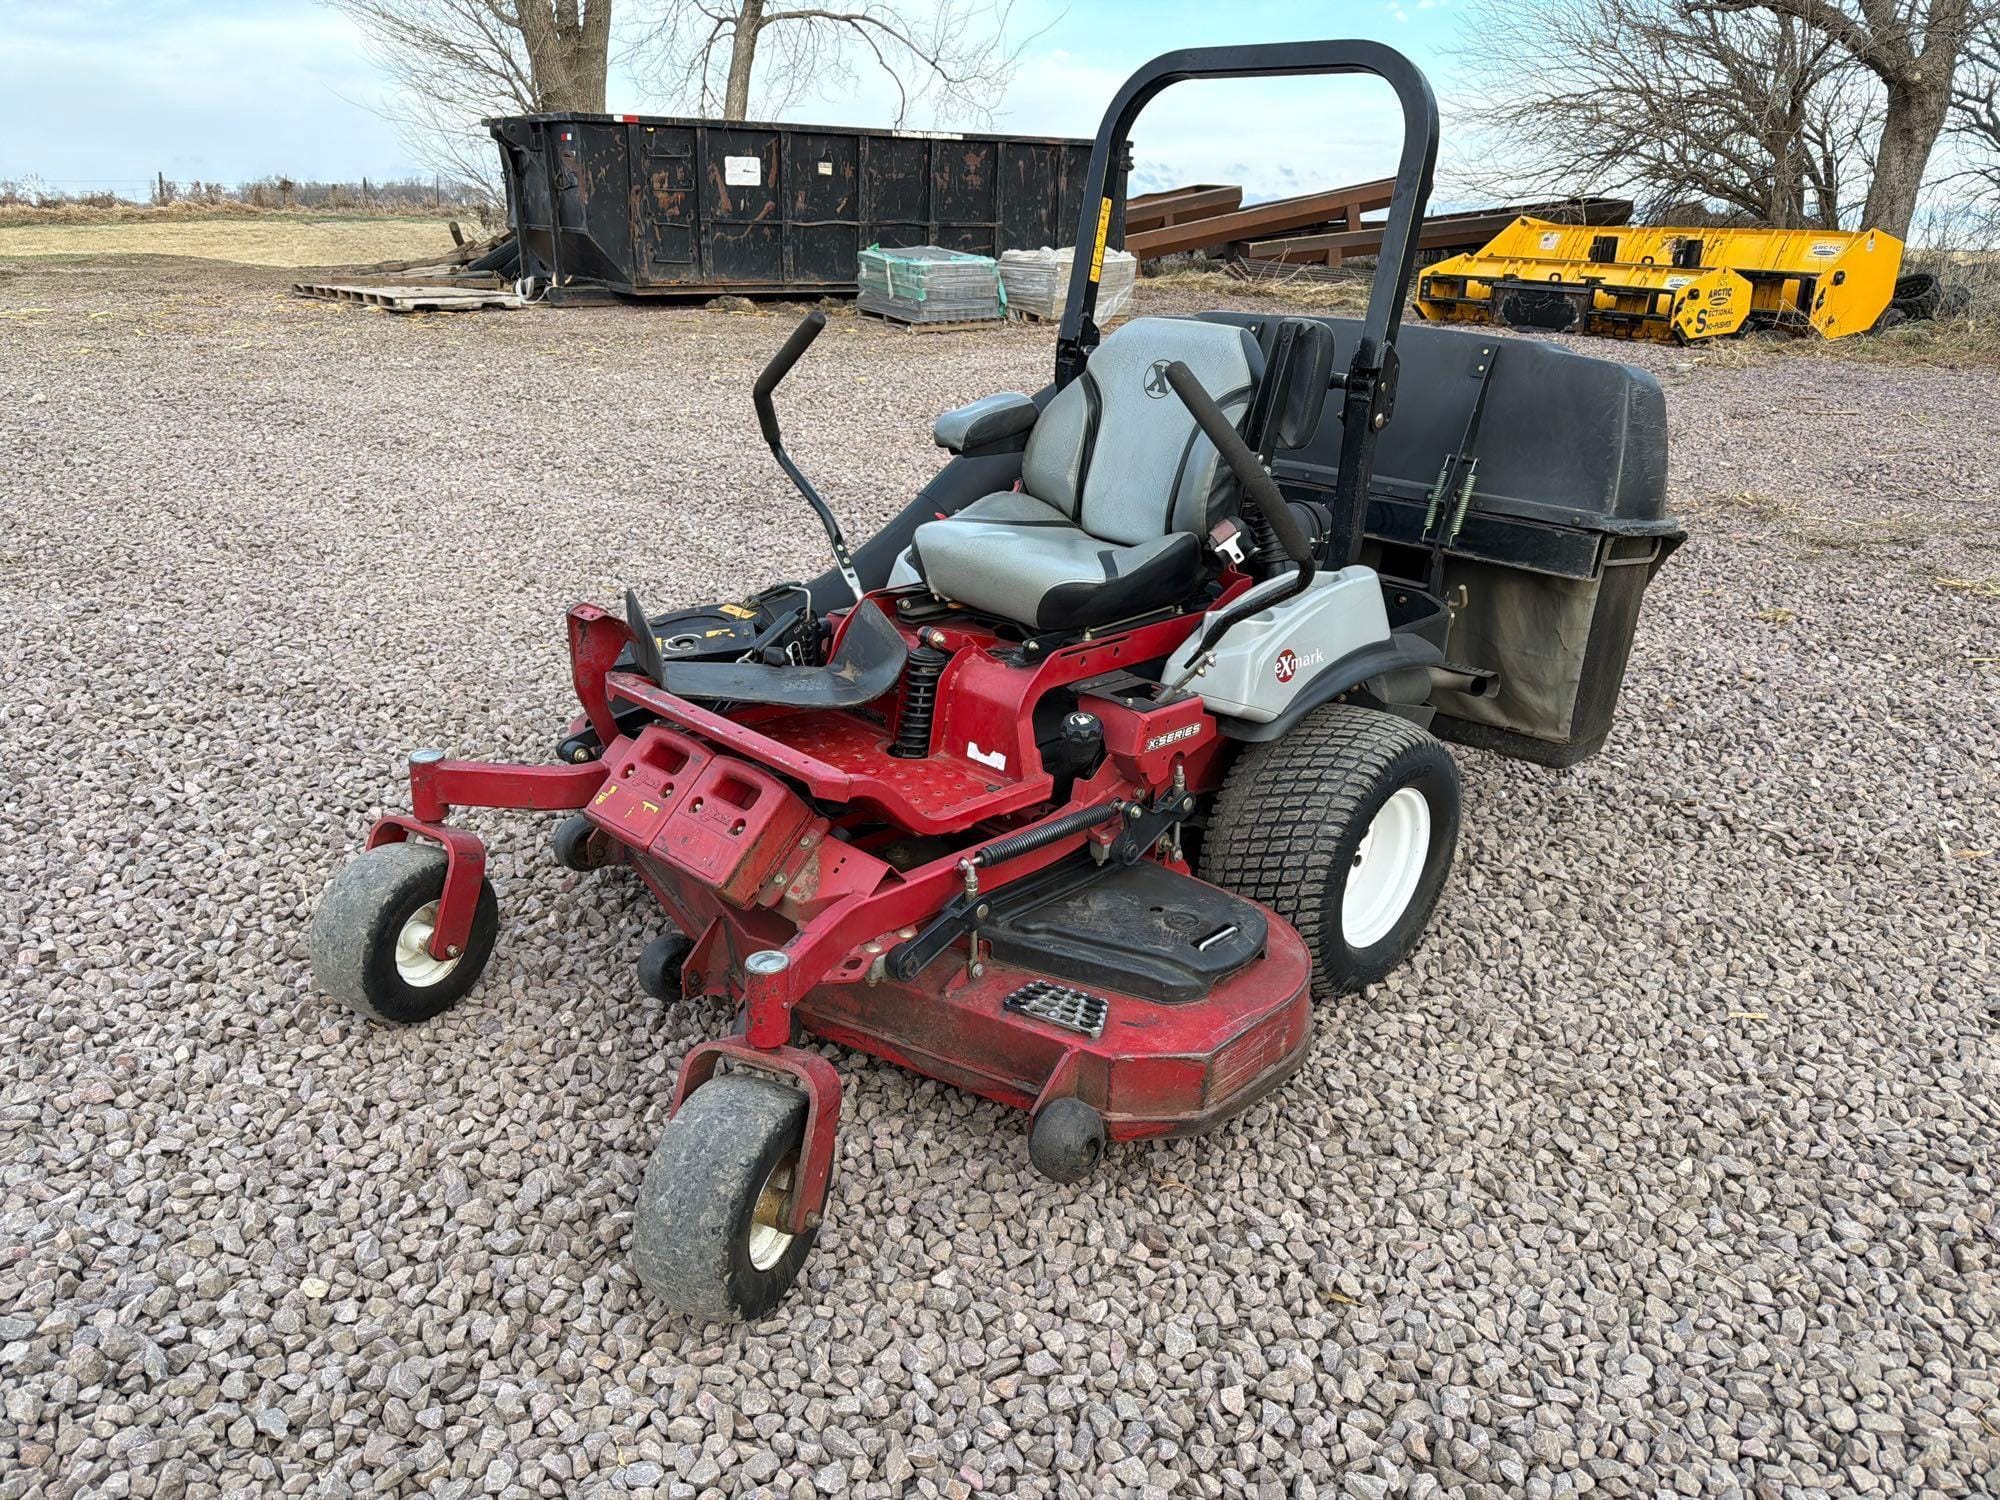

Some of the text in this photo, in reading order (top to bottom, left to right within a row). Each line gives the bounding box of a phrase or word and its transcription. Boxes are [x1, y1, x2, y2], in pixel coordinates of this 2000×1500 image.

[1812, 244, 1842, 252] ARCTIC
[1708, 287, 1733, 299] ARCTIC
[1274, 648, 1324, 679] eXmark
